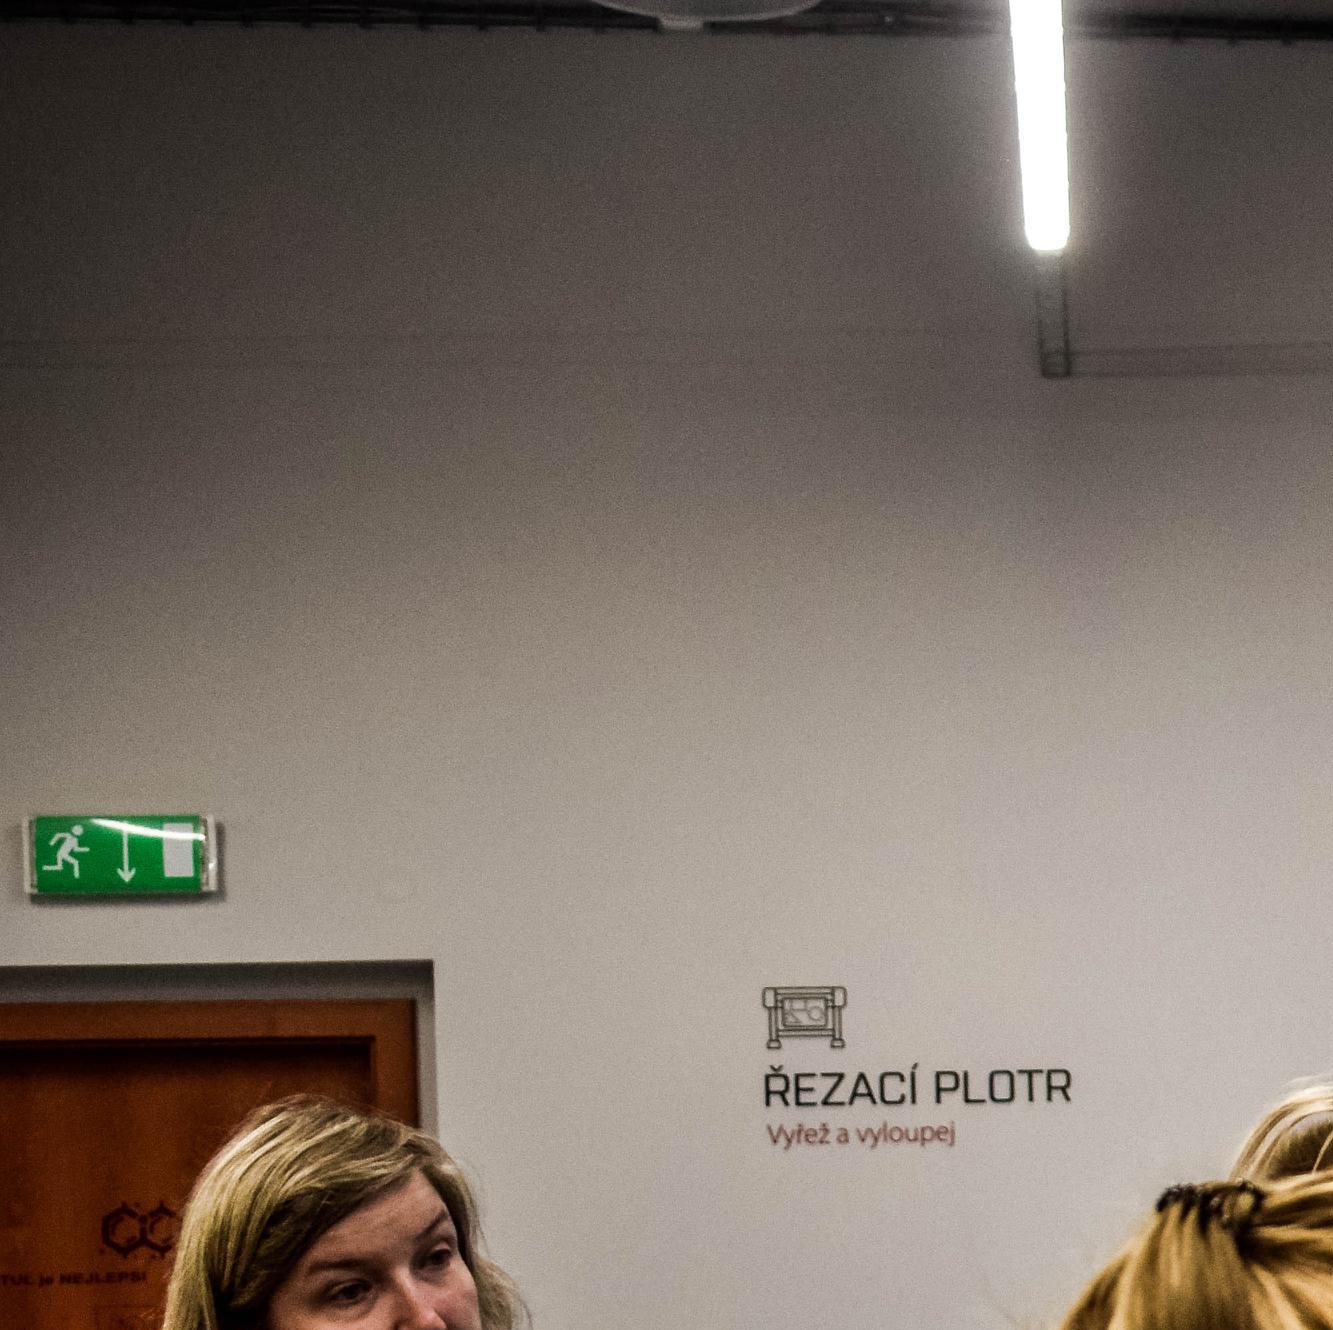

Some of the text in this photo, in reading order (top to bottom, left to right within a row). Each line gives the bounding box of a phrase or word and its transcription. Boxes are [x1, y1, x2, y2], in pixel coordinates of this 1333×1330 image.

[764, 1063, 1072, 1107] ŘEZACÍ PLOTR
[766, 1121, 956, 1151] Vyřež a vyloupej
